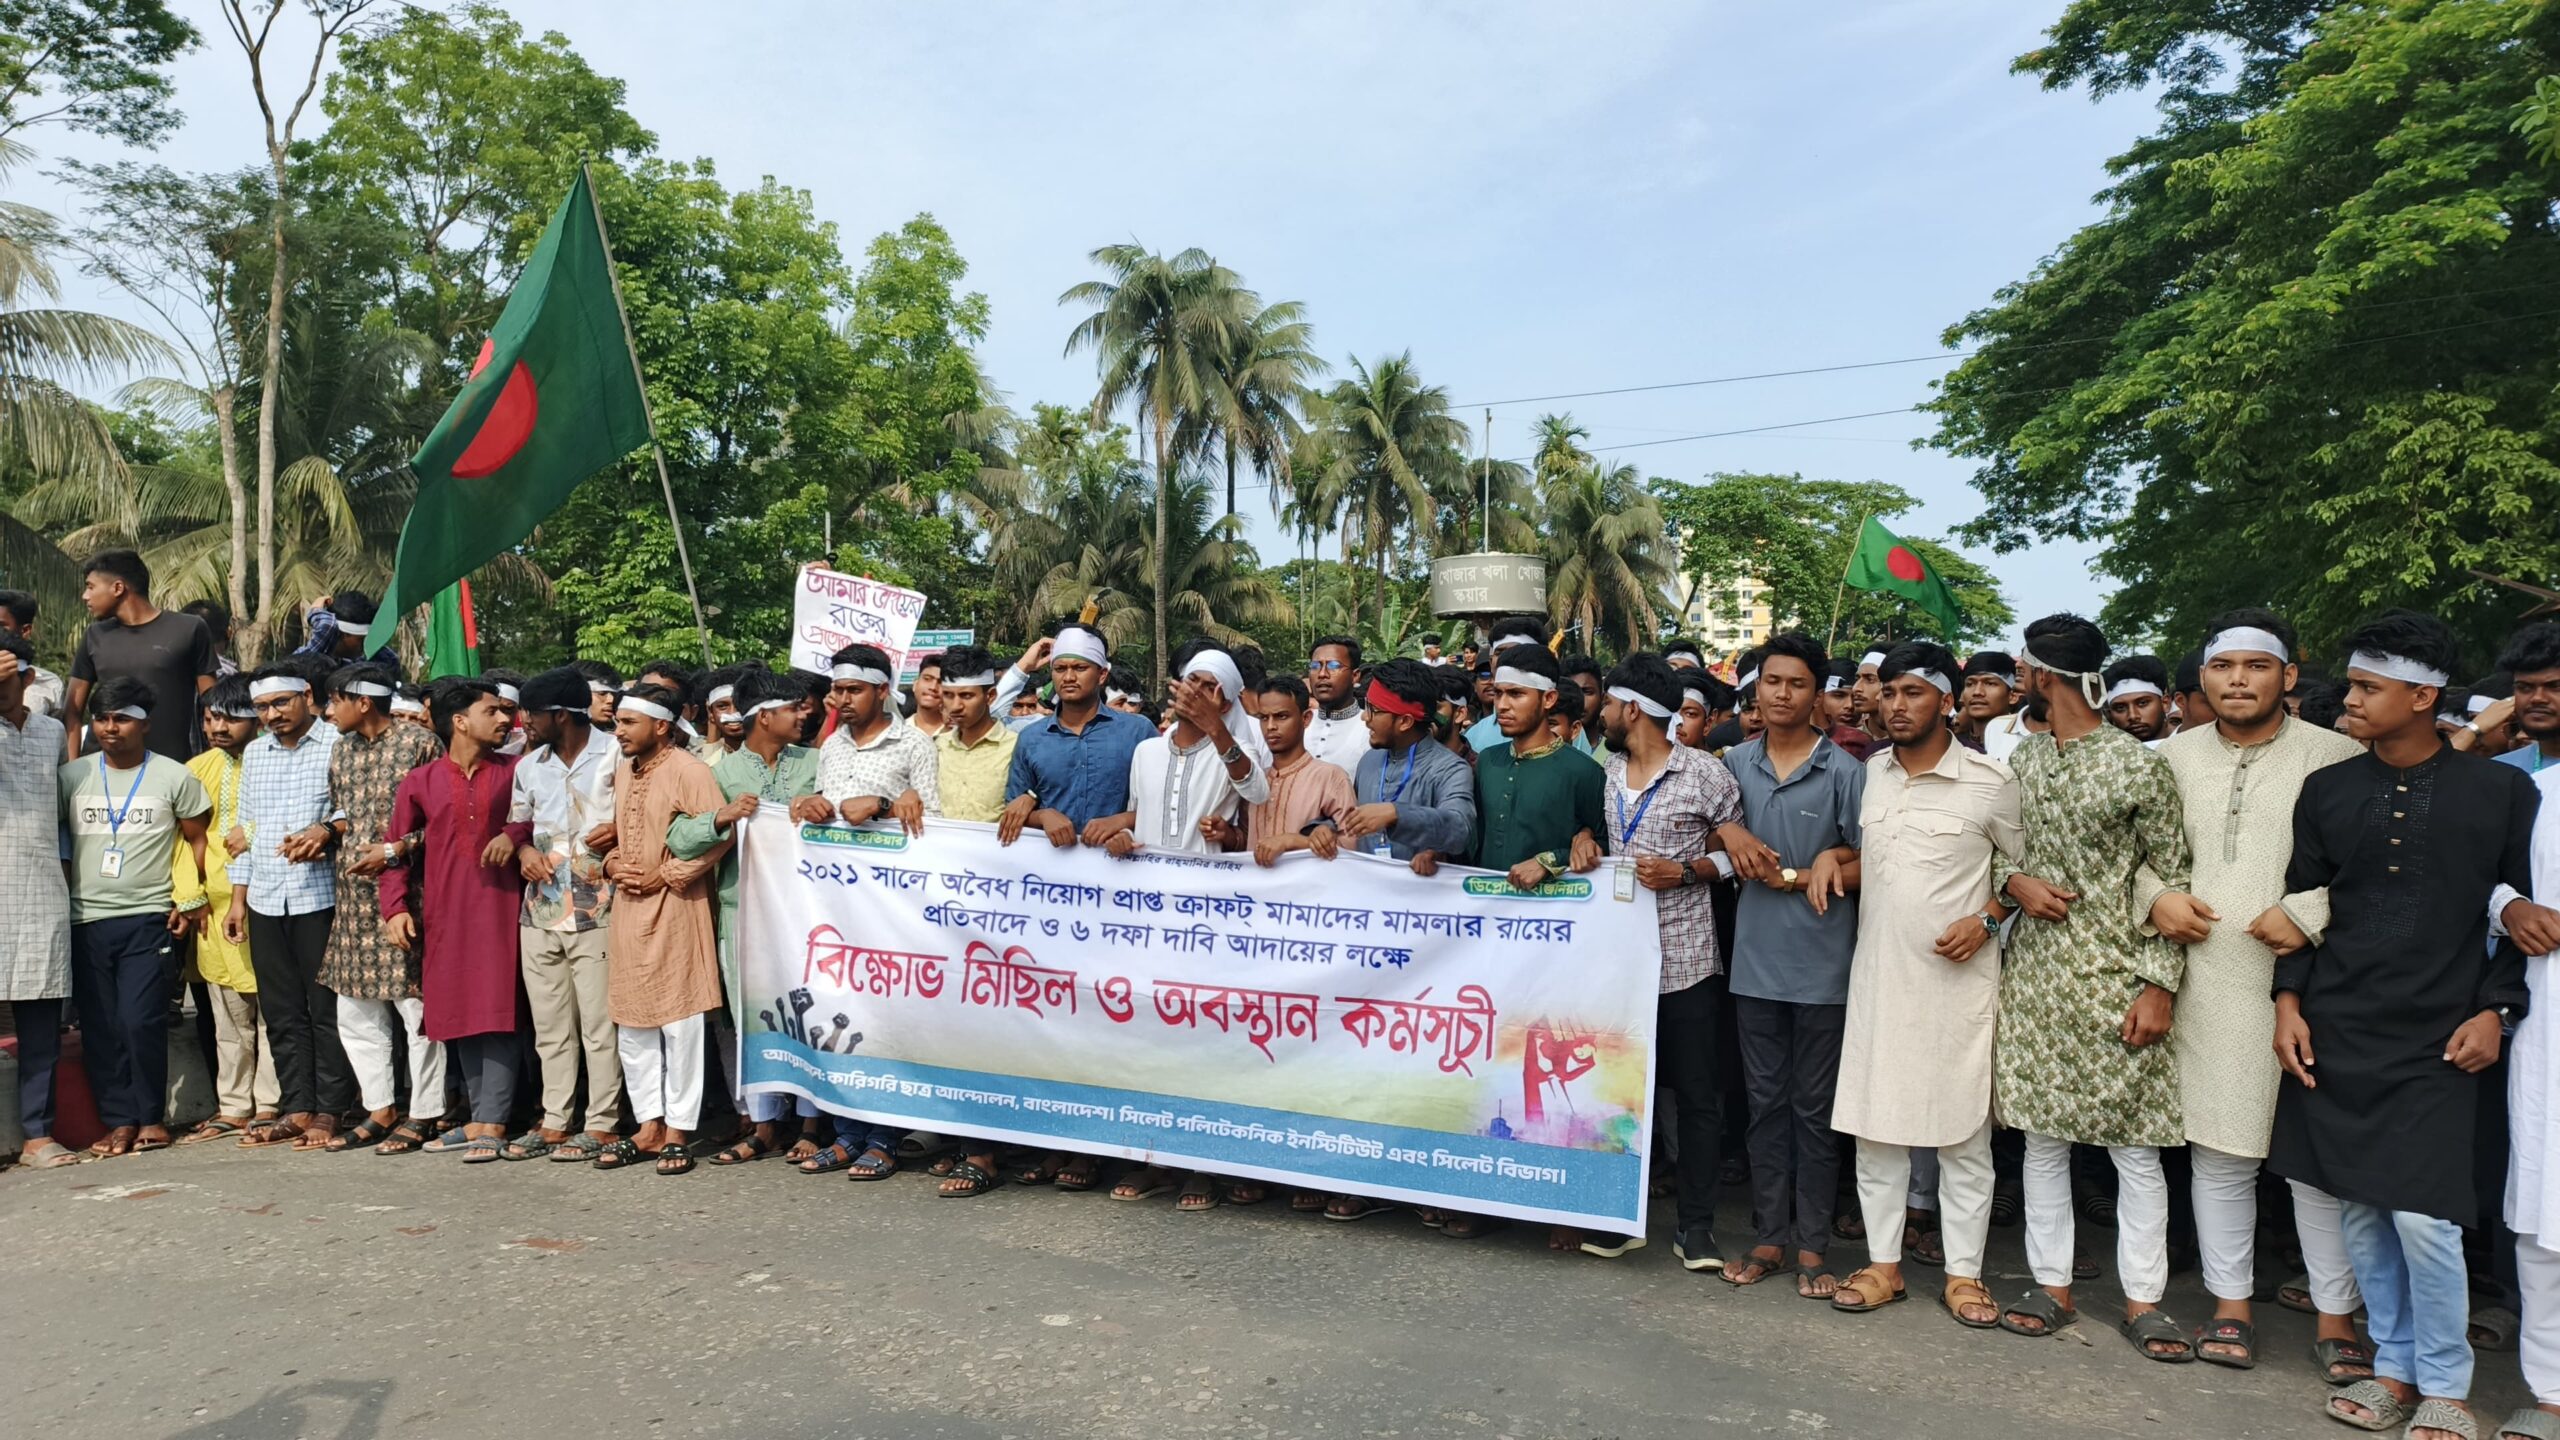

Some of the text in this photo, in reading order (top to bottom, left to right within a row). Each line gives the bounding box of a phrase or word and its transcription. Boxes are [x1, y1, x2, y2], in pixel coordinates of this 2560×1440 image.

[806, 571, 870, 606] আমার
[1482, 564, 1509, 581] খলা
[829, 603, 886, 638] রক্তের
[797, 859, 858, 886] ২০২১
[871, 865, 932, 891] সালে
[940, 868, 1014, 900] অবৈধ
[1020, 873, 1104, 909] নিয়োগ
[1113, 888, 1164, 912] প্রাপ্ত
[1265, 901, 1373, 932] মামাদের
[1381, 909, 1486, 938] মামলার
[1494, 916, 1576, 943] রায়ের
[923, 900, 1031, 936] প্রতিবাদে
[1039, 918, 1059, 936] ও
[1071, 921, 1090, 941] ৬
[1100, 921, 1154, 948] দফা
[1163, 923, 1218, 955] দাবি
[1227, 932, 1338, 965] আদায়ের
[803, 923, 1497, 1078] বিক্ষোভ মিছিল ও অবস্থান কর্মসূচী
[827, 1070, 899, 1093] কারিগরি
[899, 1079, 933, 1098] ছাত্র
[934, 1086, 1019, 1111] আন্দোলন,
[1023, 1097, 1115, 1122] বাংলাদেশ।
[1119, 1105, 1174, 1129] সিলেট
[1176, 1113, 1285, 1146] পলিটেকনিক
[1286, 1128, 1384, 1159] ইনস্টিটিউট
[1386, 1147, 1429, 1169] এবং
[1431, 1147, 1495, 1175] সিলেট
[1496, 1157, 1567, 1185] বিভাগ।
